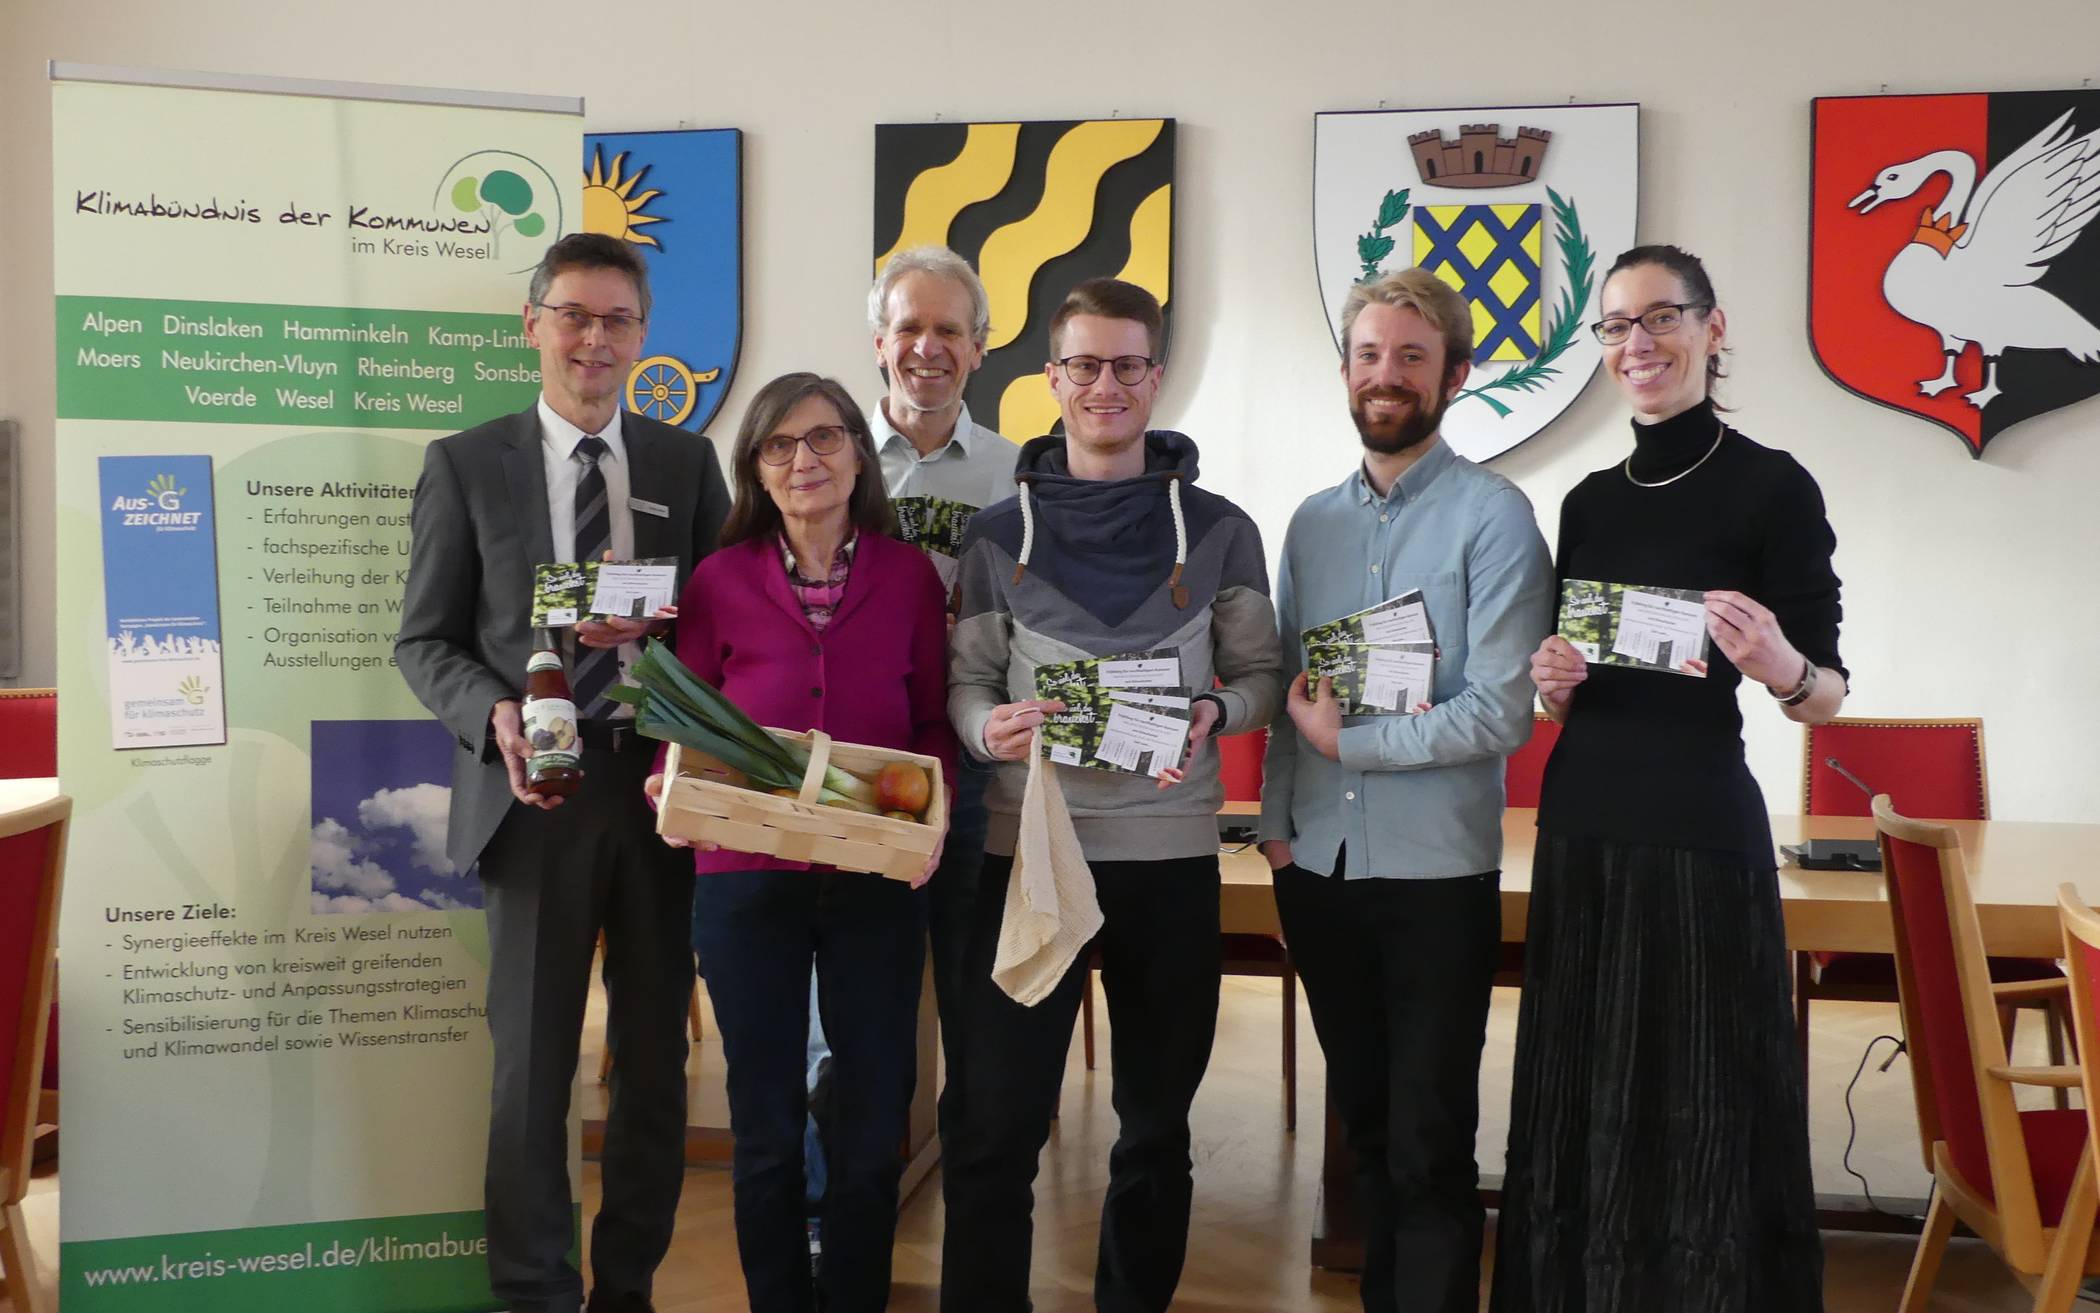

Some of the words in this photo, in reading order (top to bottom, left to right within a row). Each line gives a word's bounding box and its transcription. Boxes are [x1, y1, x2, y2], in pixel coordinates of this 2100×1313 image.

[75, 189, 261, 226] Klimabündnis
[278, 200, 331, 227] der
[348, 205, 491, 235] Kommunen
[351, 237, 376, 255] im
[382, 238, 429, 257] Kreis
[435, 240, 491, 260] Wesel
[82, 312, 143, 336] Alpen
[163, 315, 264, 339] Dinslaken
[283, 319, 408, 345] Hamminkeln
[428, 326, 527, 351] Kamp-Lint
[77, 347, 142, 370] Moers
[162, 350, 338, 377] Neukirchen-Vluyn
[358, 356, 455, 384] Rheinberg
[474, 361, 541, 384] Sonsbe
[184, 385, 257, 408] Voerde
[276, 389, 334, 410] Wesel
[354, 391, 401, 412] Kreis
[406, 393, 463, 414] Wesel
[246, 480, 314, 498] Unsere
[123, 512, 202, 526] ZEICHNET
[263, 508, 371, 528] Erfahrungen
[376, 511, 413, 528] aust
[263, 538, 390, 559] fachspezifische
[263, 568, 356, 588] Verleihung
[361, 569, 390, 585] der
[263, 596, 351, 614] Teilnahme
[358, 601, 380, 614] an
[263, 627, 376, 647] Organisation
[263, 652, 381, 670] Ausstellungen
[124, 696, 185, 710] gemeinsam
[105, 906, 175, 923] Unsere
[182, 904, 236, 921] Ziele:
[122, 930, 258, 953] Synergieeffekte
[264, 930, 286, 945] im
[295, 927, 337, 944] Kreis
[342, 925, 392, 942] Wesel
[397, 925, 453, 940] nutzen
[123, 963, 229, 984] Entwicklung
[234, 962, 267, 975] von
[272, 957, 347, 975] kreisweit
[351, 953, 442, 973] greifenden
[123, 985, 236, 1005] Klimaschutz-
[242, 982, 276, 999] und
[281, 975, 467, 999] Anpassungsstrategien
[122, 1013, 261, 1036] Sensibilisierung
[267, 1012, 291, 1028] für
[296, 1009, 324, 1026] die
[328, 1006, 398, 1025] Themen
[403, 1003, 487, 1021] Klimaschu
[123, 1042, 158, 1059] und
[164, 1036, 279, 1058] Klimawandel
[285, 1034, 333, 1050] sowie
[338, 1026, 469, 1048] Wissenstransfer
[84, 1233, 488, 1287] www.kreis-wesel.de/klimabue
